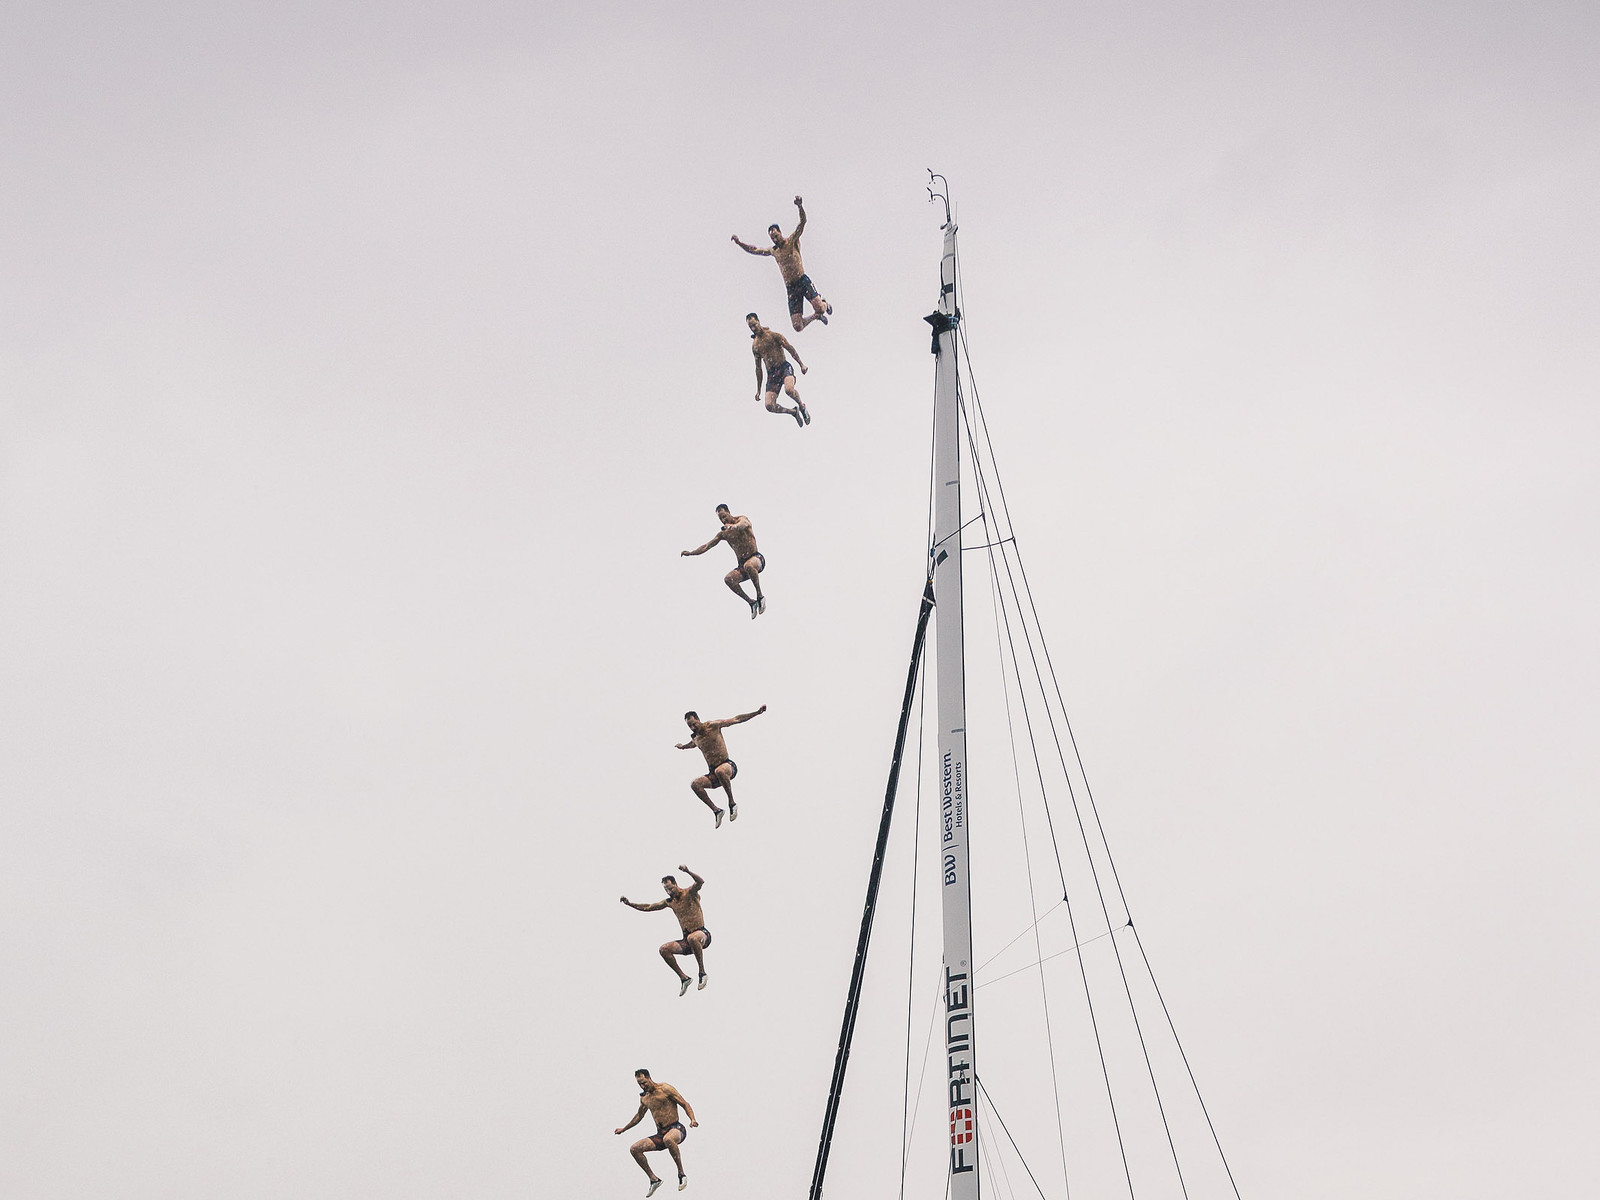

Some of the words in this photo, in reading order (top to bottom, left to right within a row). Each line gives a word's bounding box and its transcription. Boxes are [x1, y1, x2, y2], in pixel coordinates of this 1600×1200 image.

[943, 752, 953, 811] Western
[955, 793, 962, 801] &
[943, 810, 953, 842] Best
[944, 854, 957, 886] BW
[945, 966, 974, 1175] FORTINET
